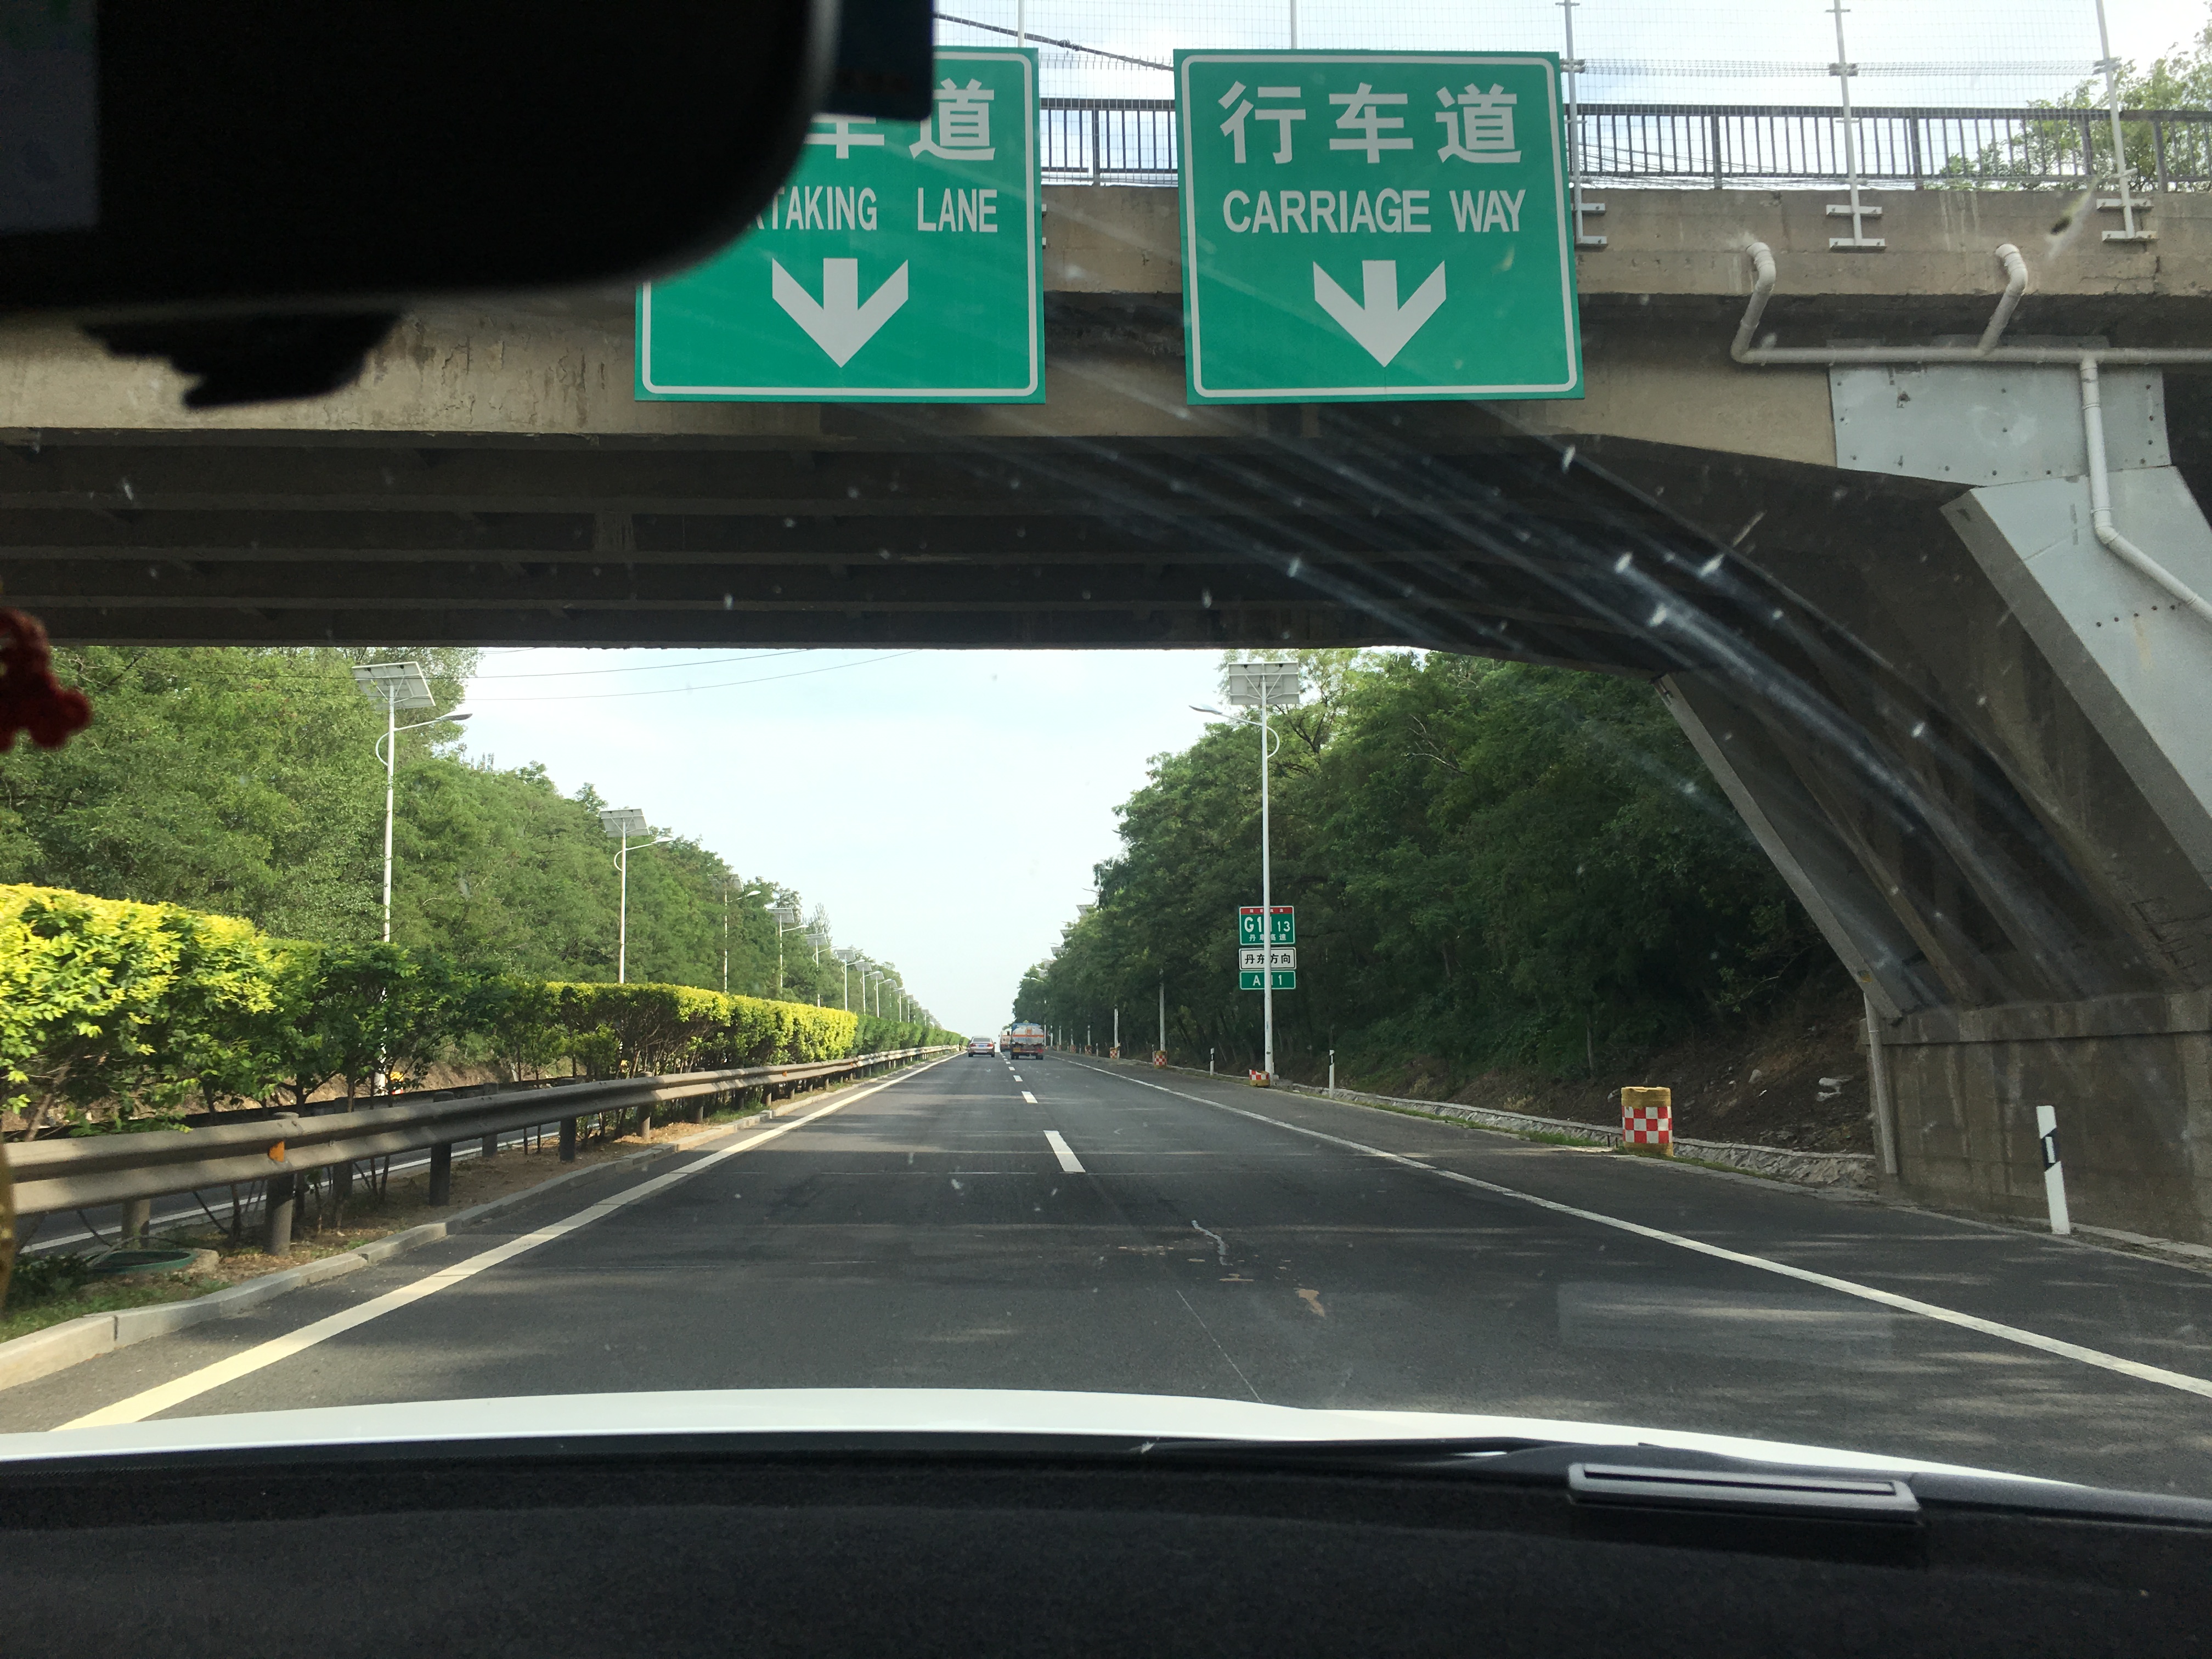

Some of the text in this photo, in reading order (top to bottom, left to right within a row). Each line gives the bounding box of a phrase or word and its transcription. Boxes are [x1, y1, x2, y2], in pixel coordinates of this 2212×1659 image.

[1218, 81, 1522, 164] 行车道
[918, 188, 998, 233] LANE
[1223, 188, 1526, 233] CARRIAGE WAY
[1245, 953, 1290, 964] 丹东方向
